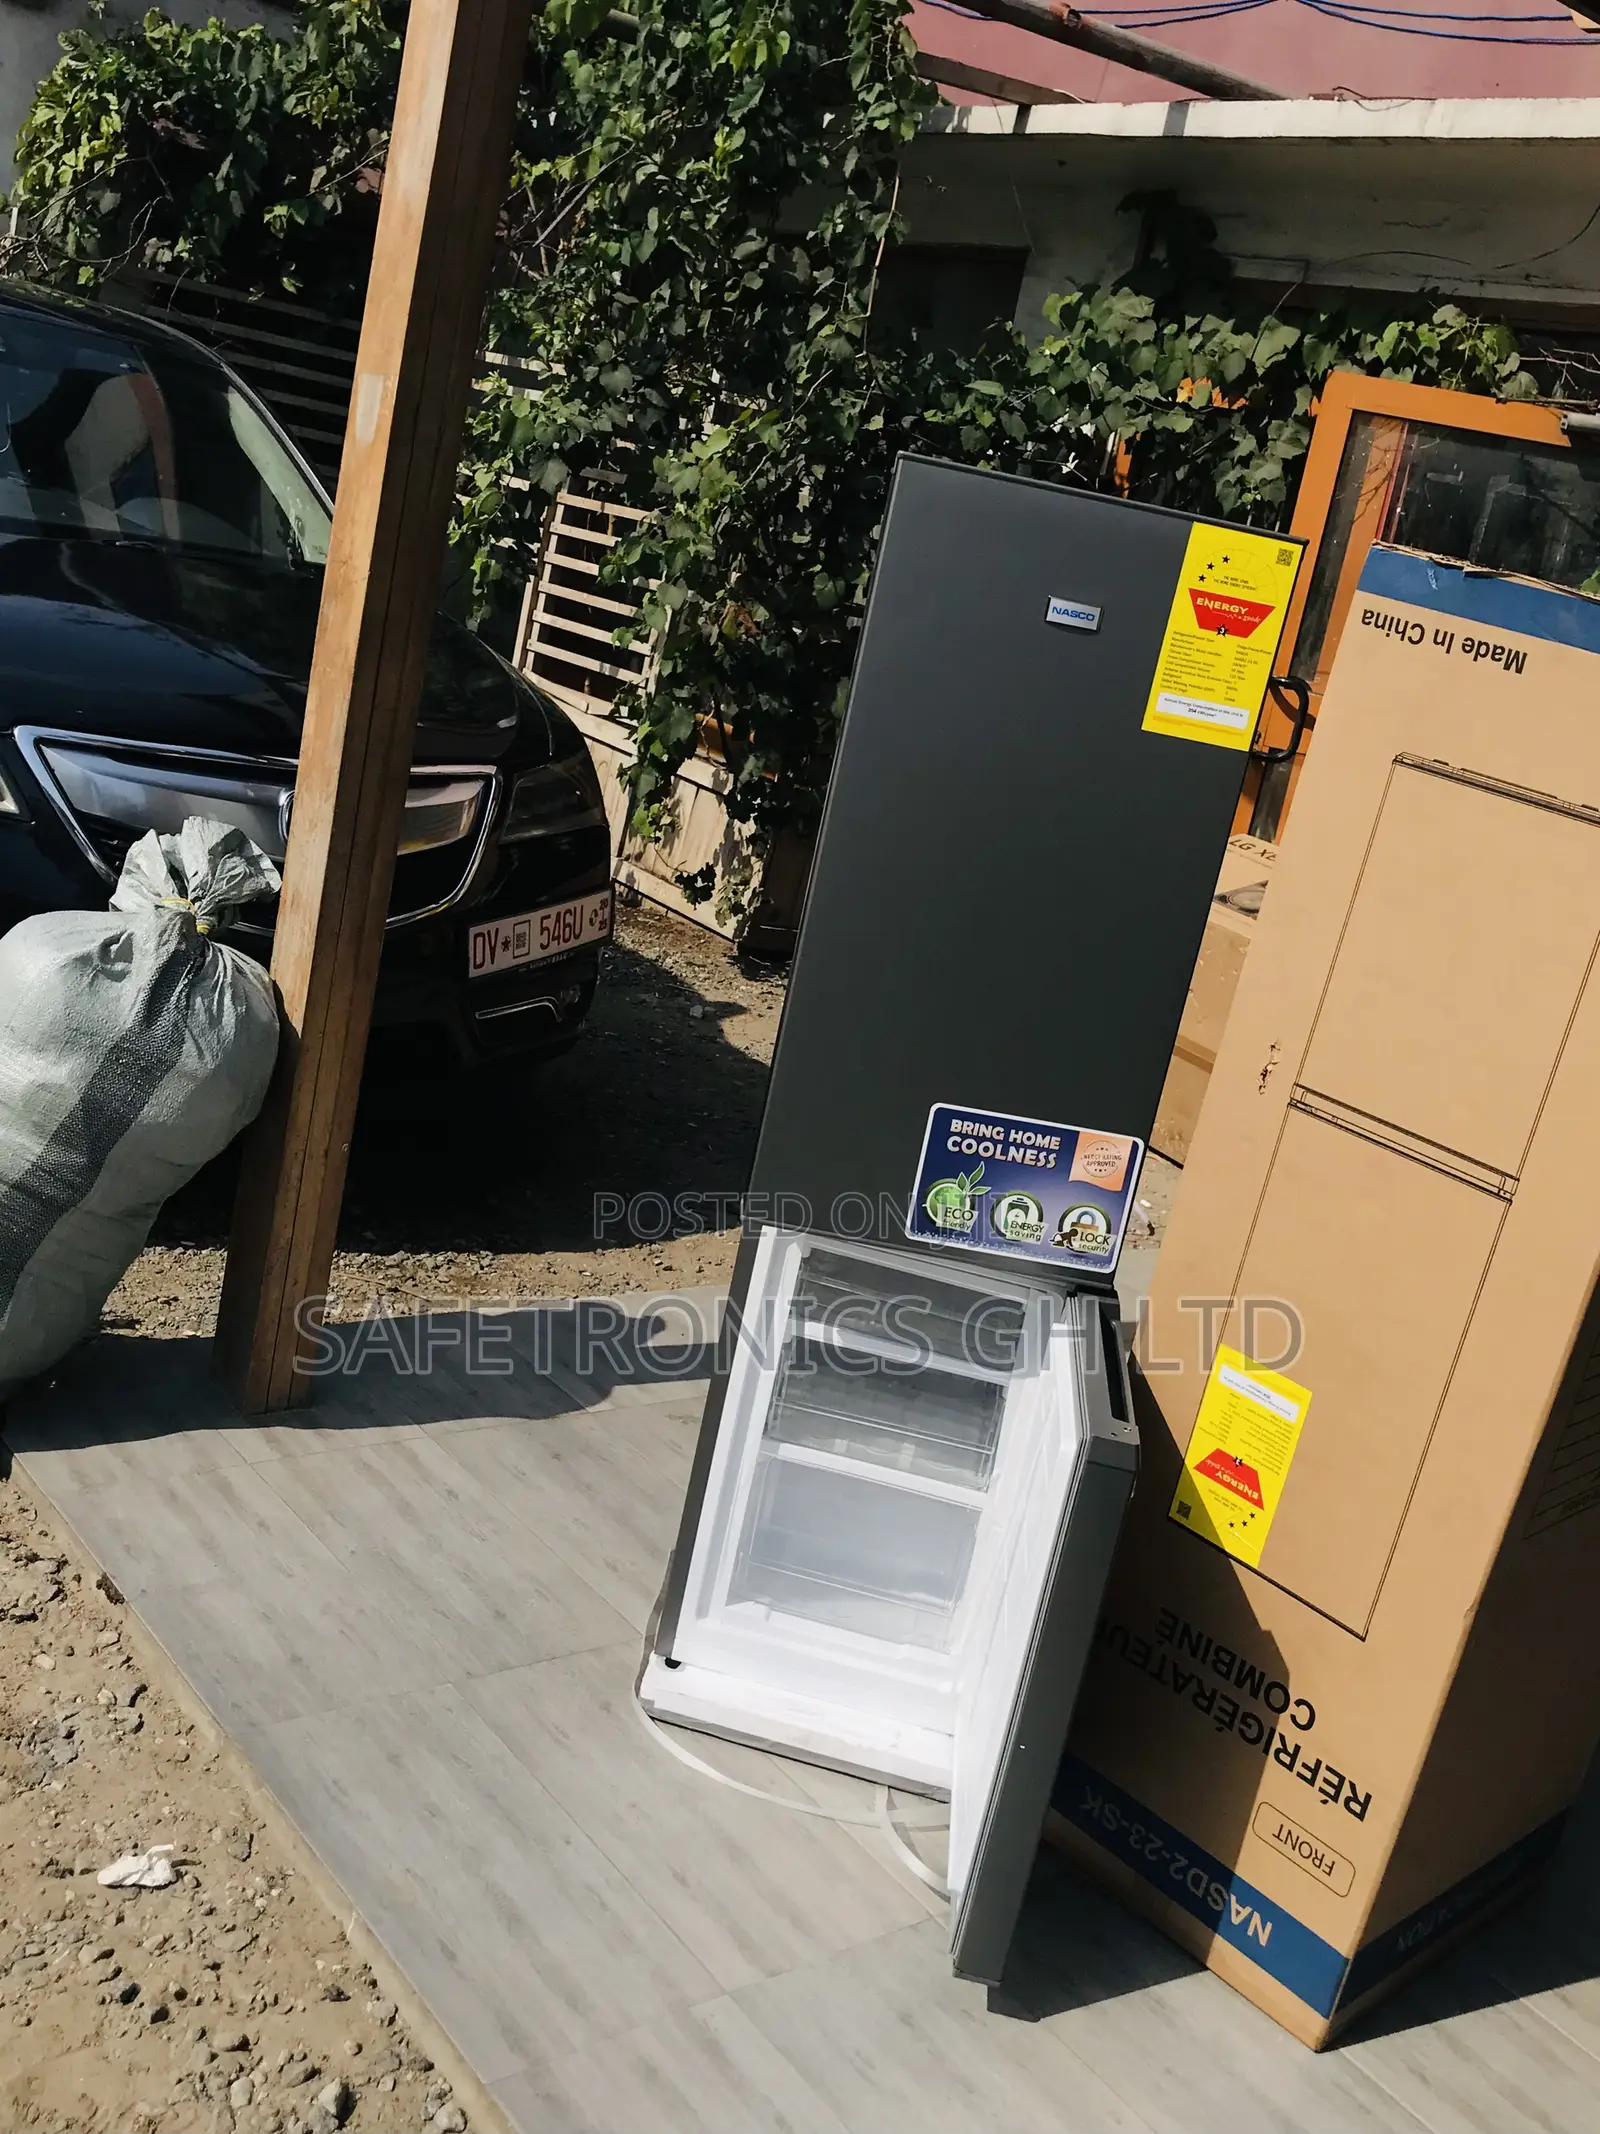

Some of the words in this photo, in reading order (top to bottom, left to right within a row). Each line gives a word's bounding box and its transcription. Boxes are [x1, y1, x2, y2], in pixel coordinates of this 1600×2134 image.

[1052, 606, 1096, 622] NASCO
[1196, 597, 1249, 615] ENERGY
[1361, 608, 1426, 646] China
[1432, 628, 1455, 654] In
[1461, 636, 1528, 675] Made
[473, 927, 499, 970] DV
[540, 904, 584, 951] 546U
[950, 1119, 1005, 1140] BRING
[1009, 1129, 1061, 1151] HOME
[947, 1136, 1057, 1169] COOLNESS
[944, 1207, 973, 1222] ECO
[1010, 1221, 1045, 1233] ENERGY
[1009, 1230, 1042, 1242] saving
[1078, 1243, 1109, 1254] security
[1080, 1232, 1112, 1246] LOCK
[1215, 1470, 1259, 1500] ENERGY
[1155, 1606, 1316, 1731] COMBINÉ
[1272, 1823, 1336, 1877] FRONT
[1078, 1786, 1273, 1947] NASD2-23-SK
